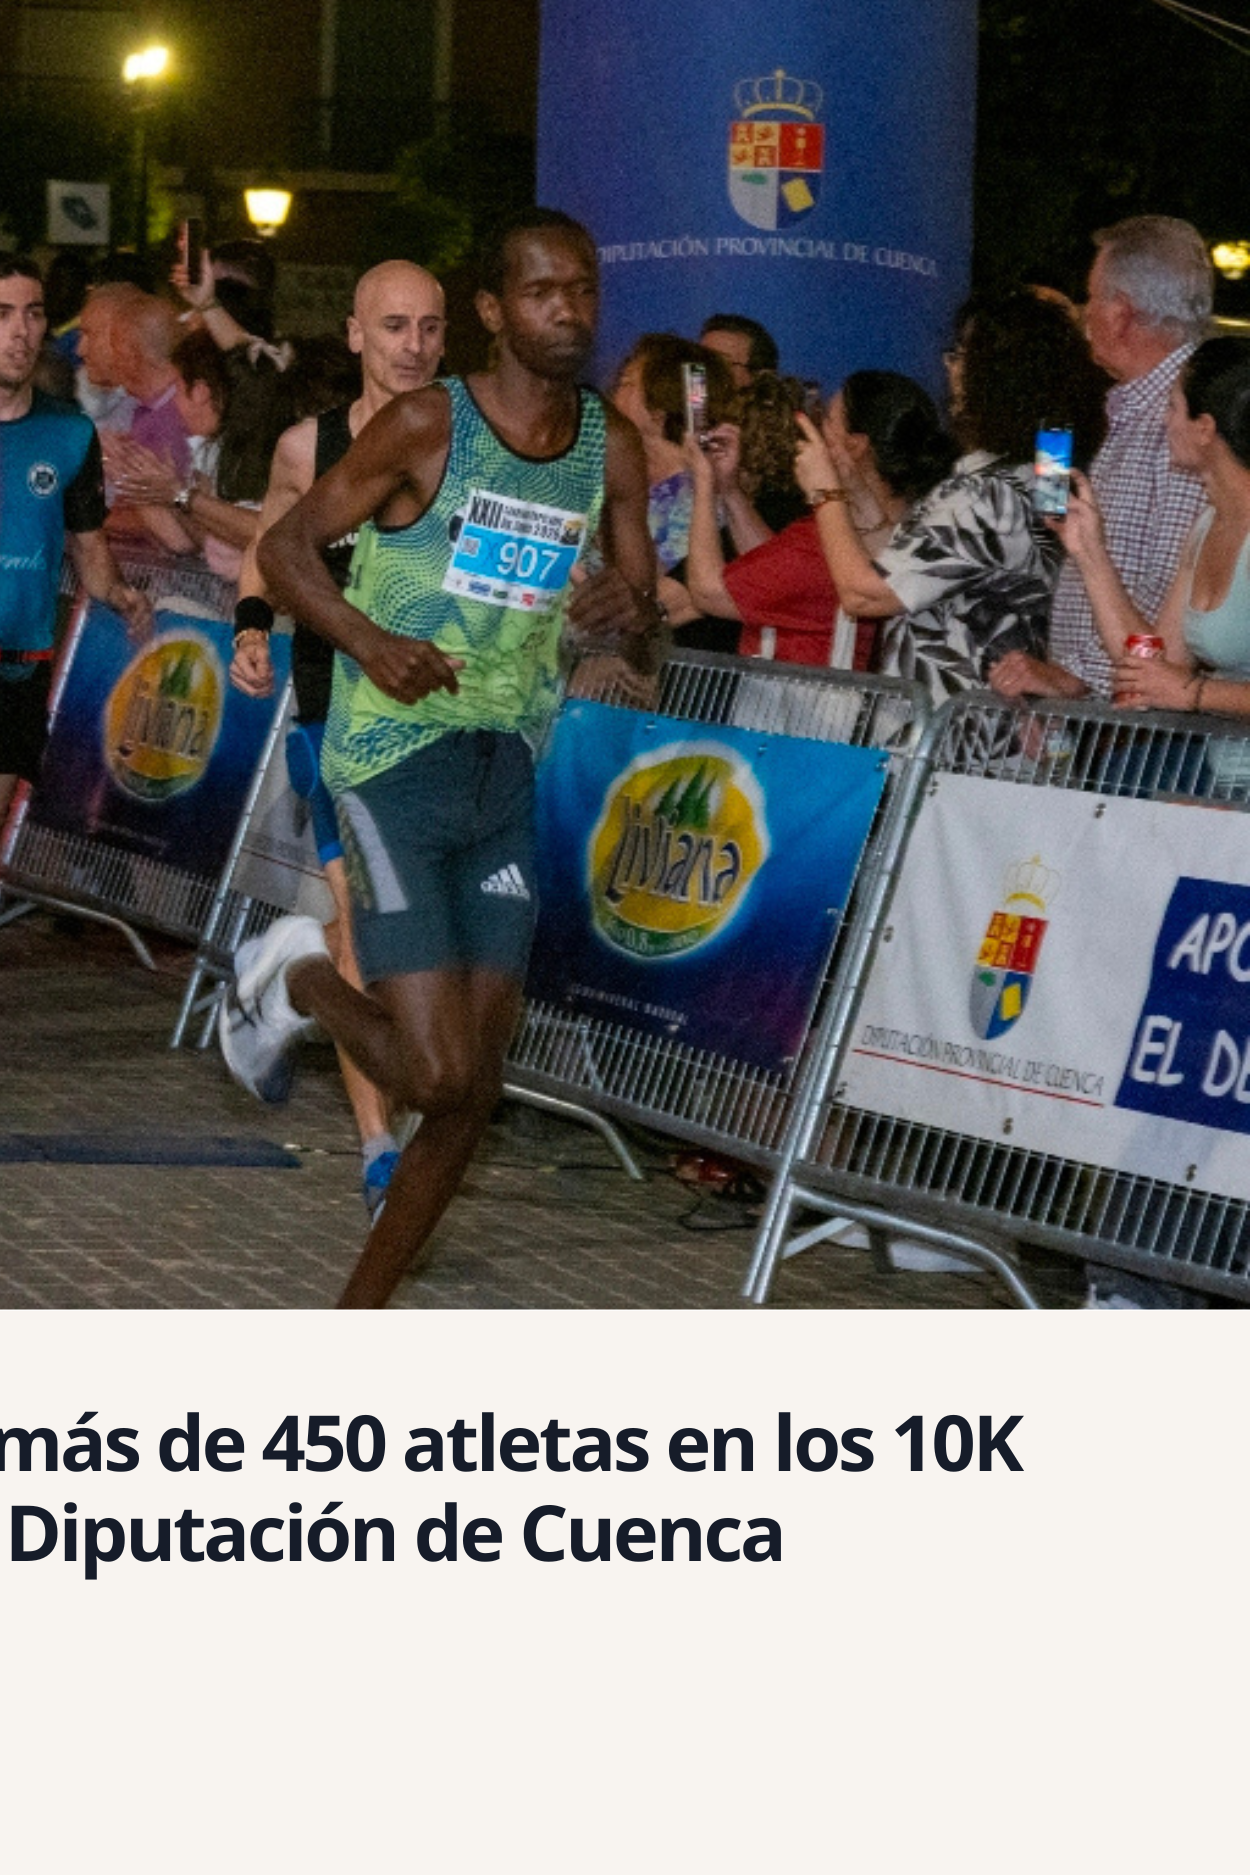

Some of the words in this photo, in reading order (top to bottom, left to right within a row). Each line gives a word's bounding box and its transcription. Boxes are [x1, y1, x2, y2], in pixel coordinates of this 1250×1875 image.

[716, 236, 838, 260] PROVINCIAL
[843, 242, 871, 263] DE
[874, 247, 939, 277] CUENCA
[468, 496, 503, 529] XXII
[497, 542, 561, 582] 907
[861, 1025, 944, 1061] DIPUTACIÓN
[944, 1041, 1020, 1080] PROVINCIAL
[1022, 1060, 1043, 1085] DE
[1044, 1063, 1104, 1095] CUENCA
[1130, 1015, 1184, 1087] EL
